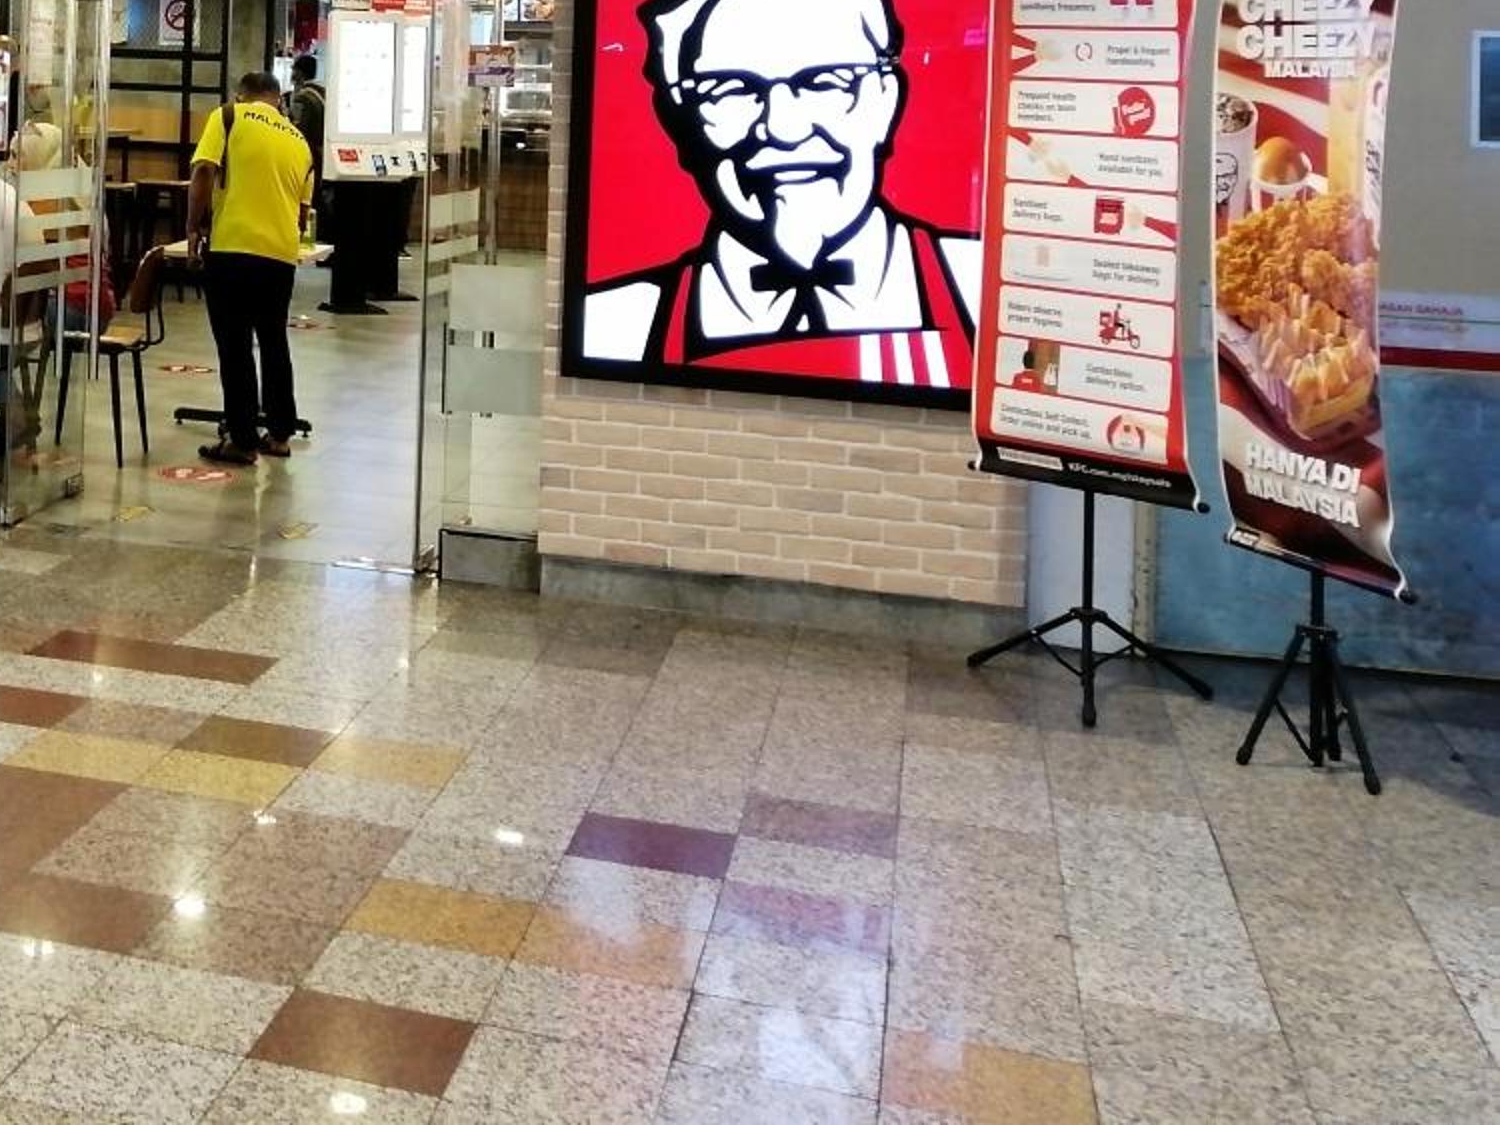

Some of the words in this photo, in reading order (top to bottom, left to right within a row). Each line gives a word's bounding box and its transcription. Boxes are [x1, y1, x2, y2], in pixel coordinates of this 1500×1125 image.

[1245, 441, 1328, 486] HANYA
[1331, 462, 1362, 495] DI
[1243, 473, 1361, 529] MALAYSIA
